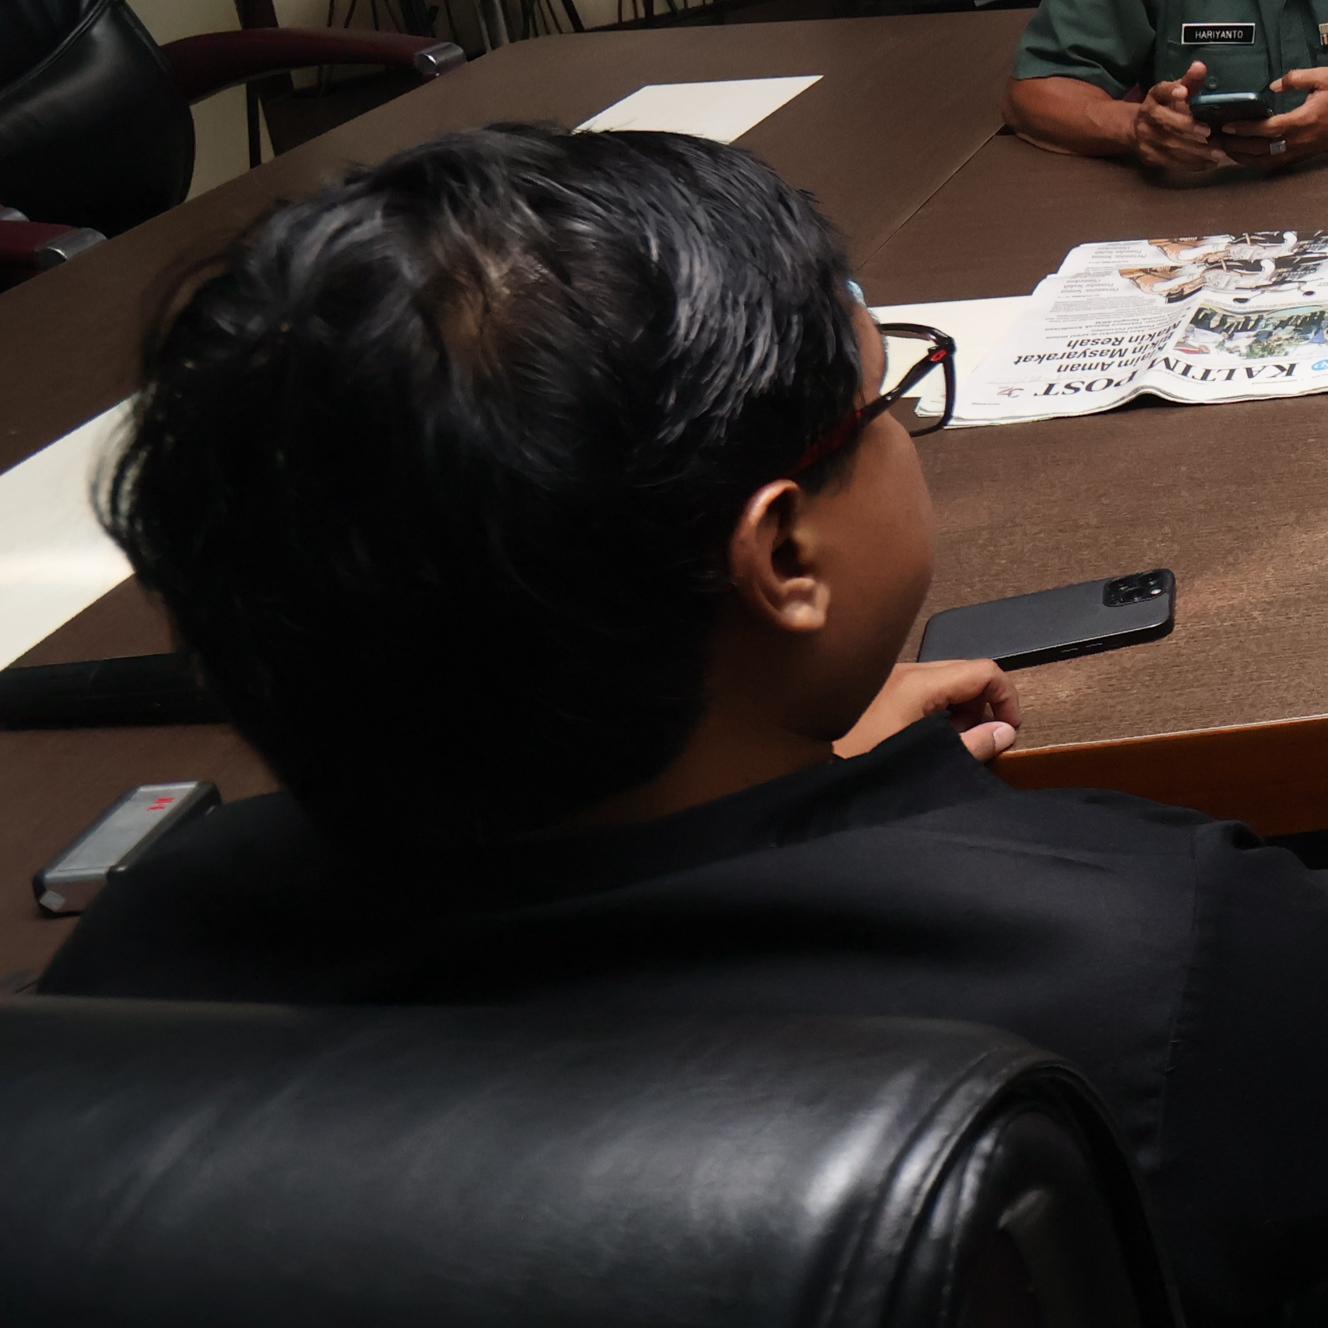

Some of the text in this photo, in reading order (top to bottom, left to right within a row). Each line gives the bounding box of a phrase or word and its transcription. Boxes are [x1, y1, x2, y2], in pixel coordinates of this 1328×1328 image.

[1195, 30, 1244, 39] HARIYANTO
[1066, 336, 1125, 349] Resah
[1013, 348, 1129, 366] Masyarakat
[1056, 361, 1116, 374] Aman
[1148, 357, 1299, 382] KALTIM
[1034, 370, 1139, 397] POST
